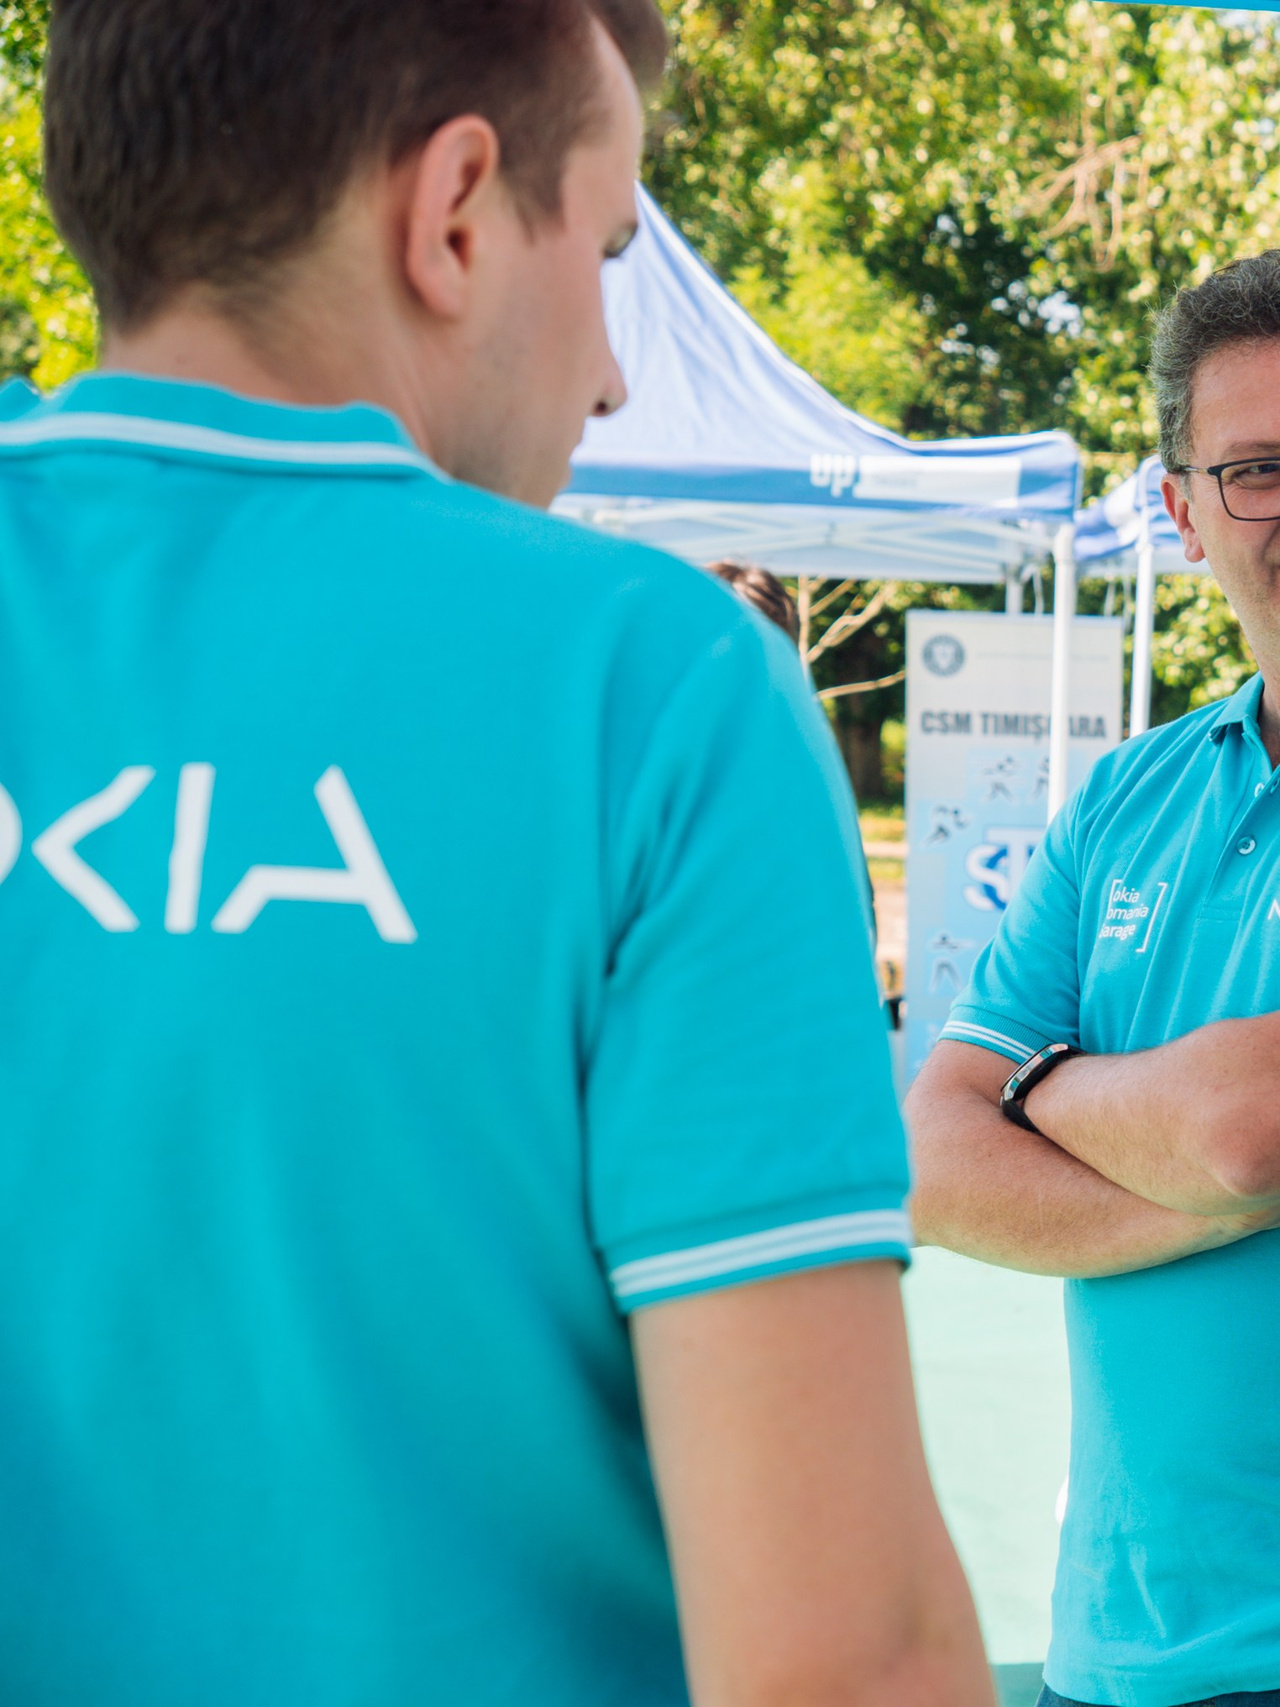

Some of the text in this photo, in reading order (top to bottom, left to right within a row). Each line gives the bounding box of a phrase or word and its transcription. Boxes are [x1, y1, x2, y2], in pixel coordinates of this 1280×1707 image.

[921, 710, 972, 735] CSM
[0, 761, 418, 945] KIA
[1112, 886, 1140, 904] okia
[1105, 903, 1149, 920] omania
